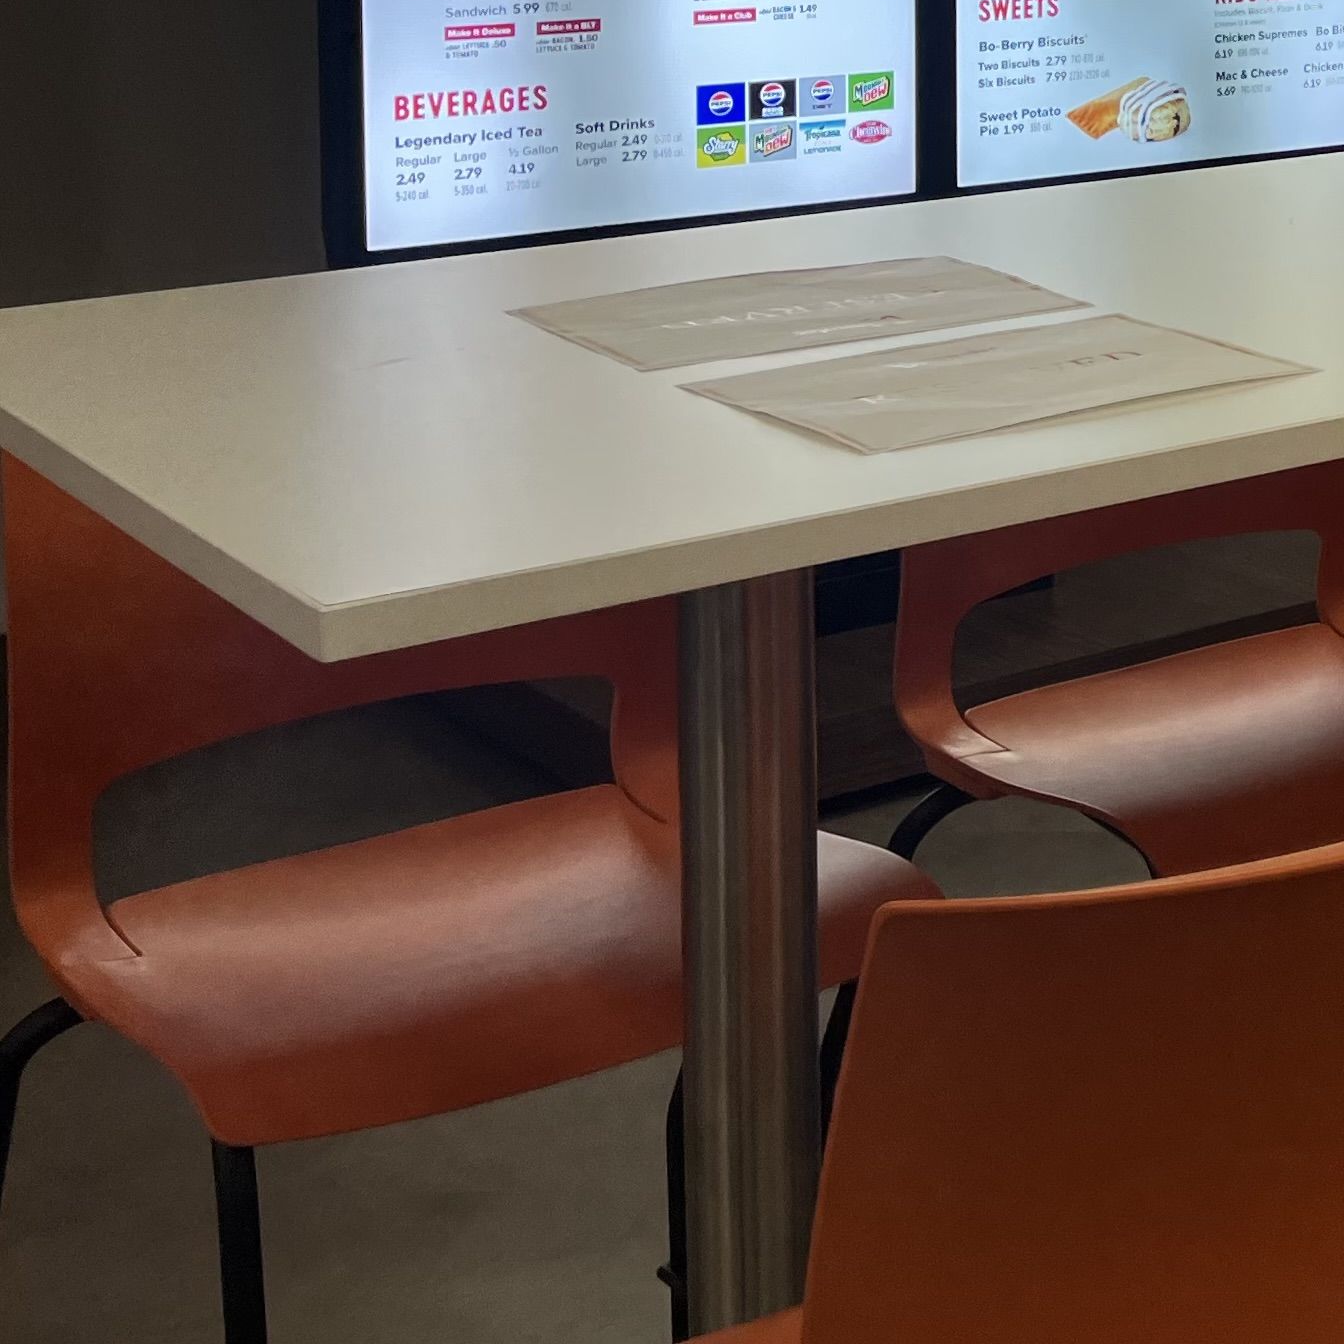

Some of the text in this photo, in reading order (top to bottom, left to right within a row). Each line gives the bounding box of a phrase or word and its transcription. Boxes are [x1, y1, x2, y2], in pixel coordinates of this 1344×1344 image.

[445, 3, 540, 18] Sandwich 5.99
[979, 35, 1085, 52] Bo-Berry Biscuits
[394, 85, 548, 122] BEVERAGES
[979, 108, 1061, 123] Sweet Potato
[575, 119, 654, 135] Soft Drinks
[980, 124, 1024, 136] Pie 1.99
[394, 127, 542, 150] Legendary Iced Tea
